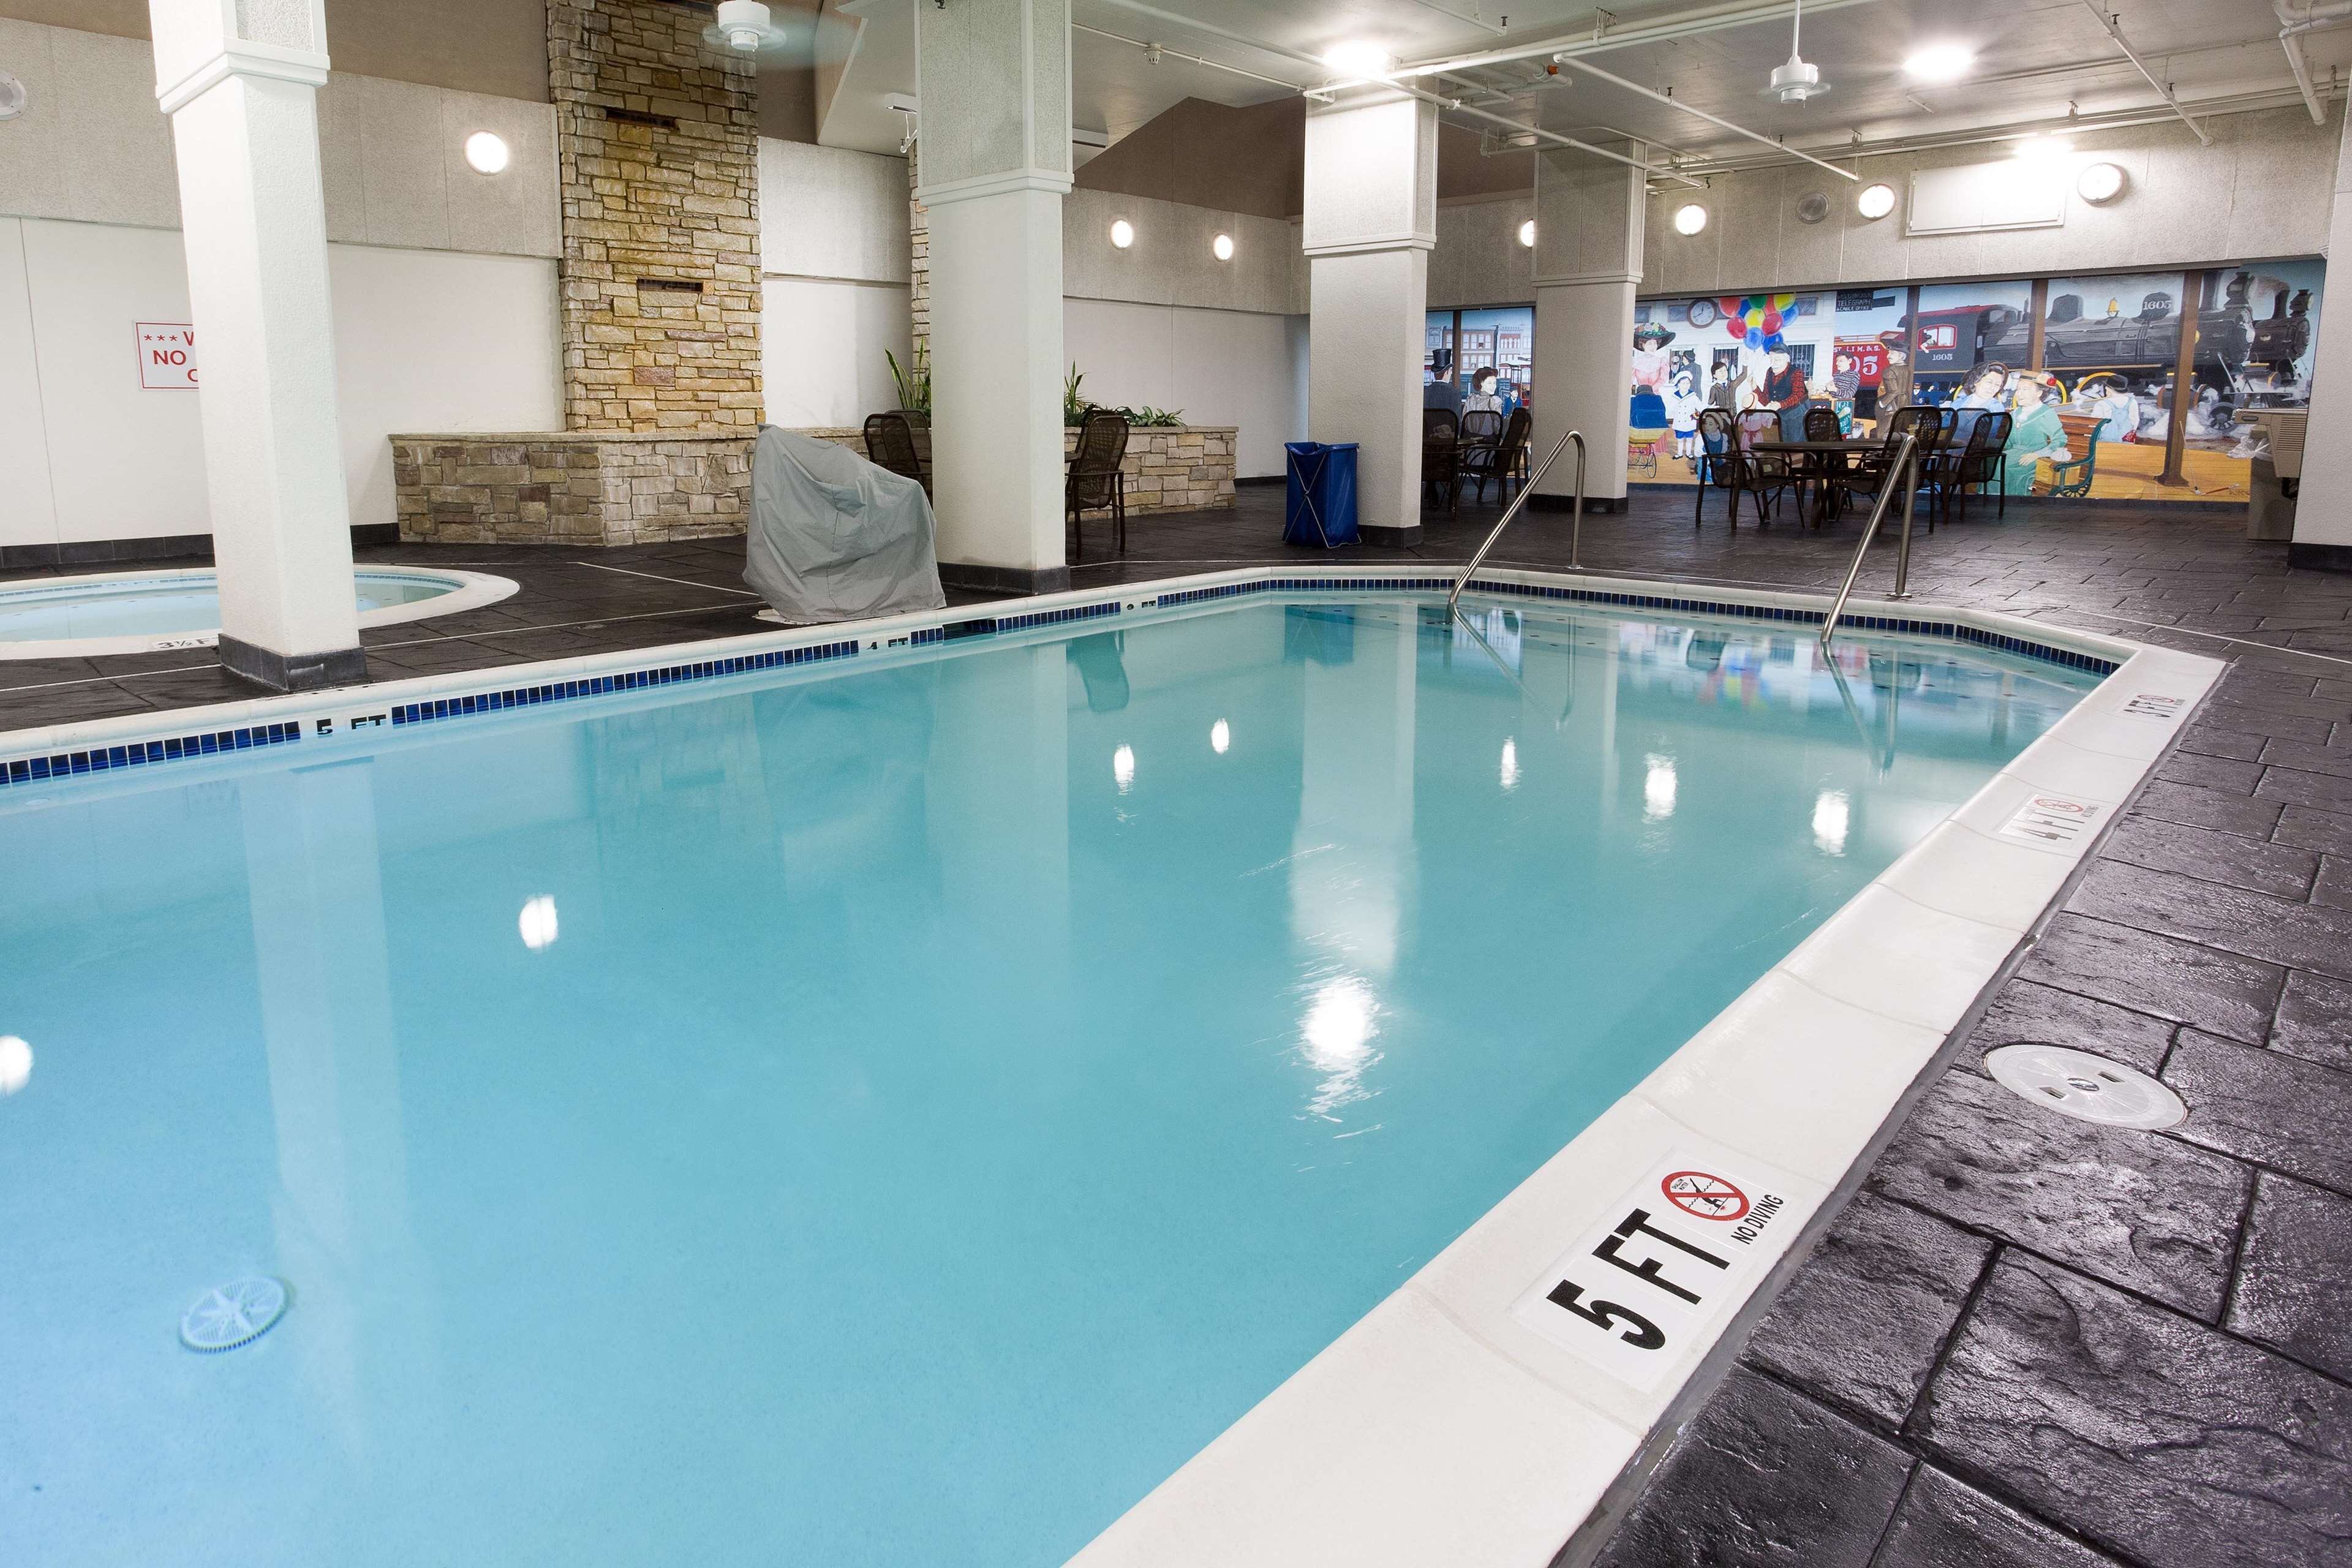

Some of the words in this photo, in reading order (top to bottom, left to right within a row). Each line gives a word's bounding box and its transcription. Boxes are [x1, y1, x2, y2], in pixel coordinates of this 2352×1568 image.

[2143, 300, 2172, 311] 1605
[153, 350, 186, 366] NO
[888, 636, 908, 647] FT
[2128, 699, 2177, 713] FT
[316, 718, 333, 735] 5
[350, 714, 386, 730] FT
[2019, 827, 2073, 840] 4
[1743, 1194, 1784, 1230] DIVING
[1730, 1226, 1758, 1245] NO
[1591, 1207, 1730, 1305] FT
[1546, 1278, 1667, 1351] 5
